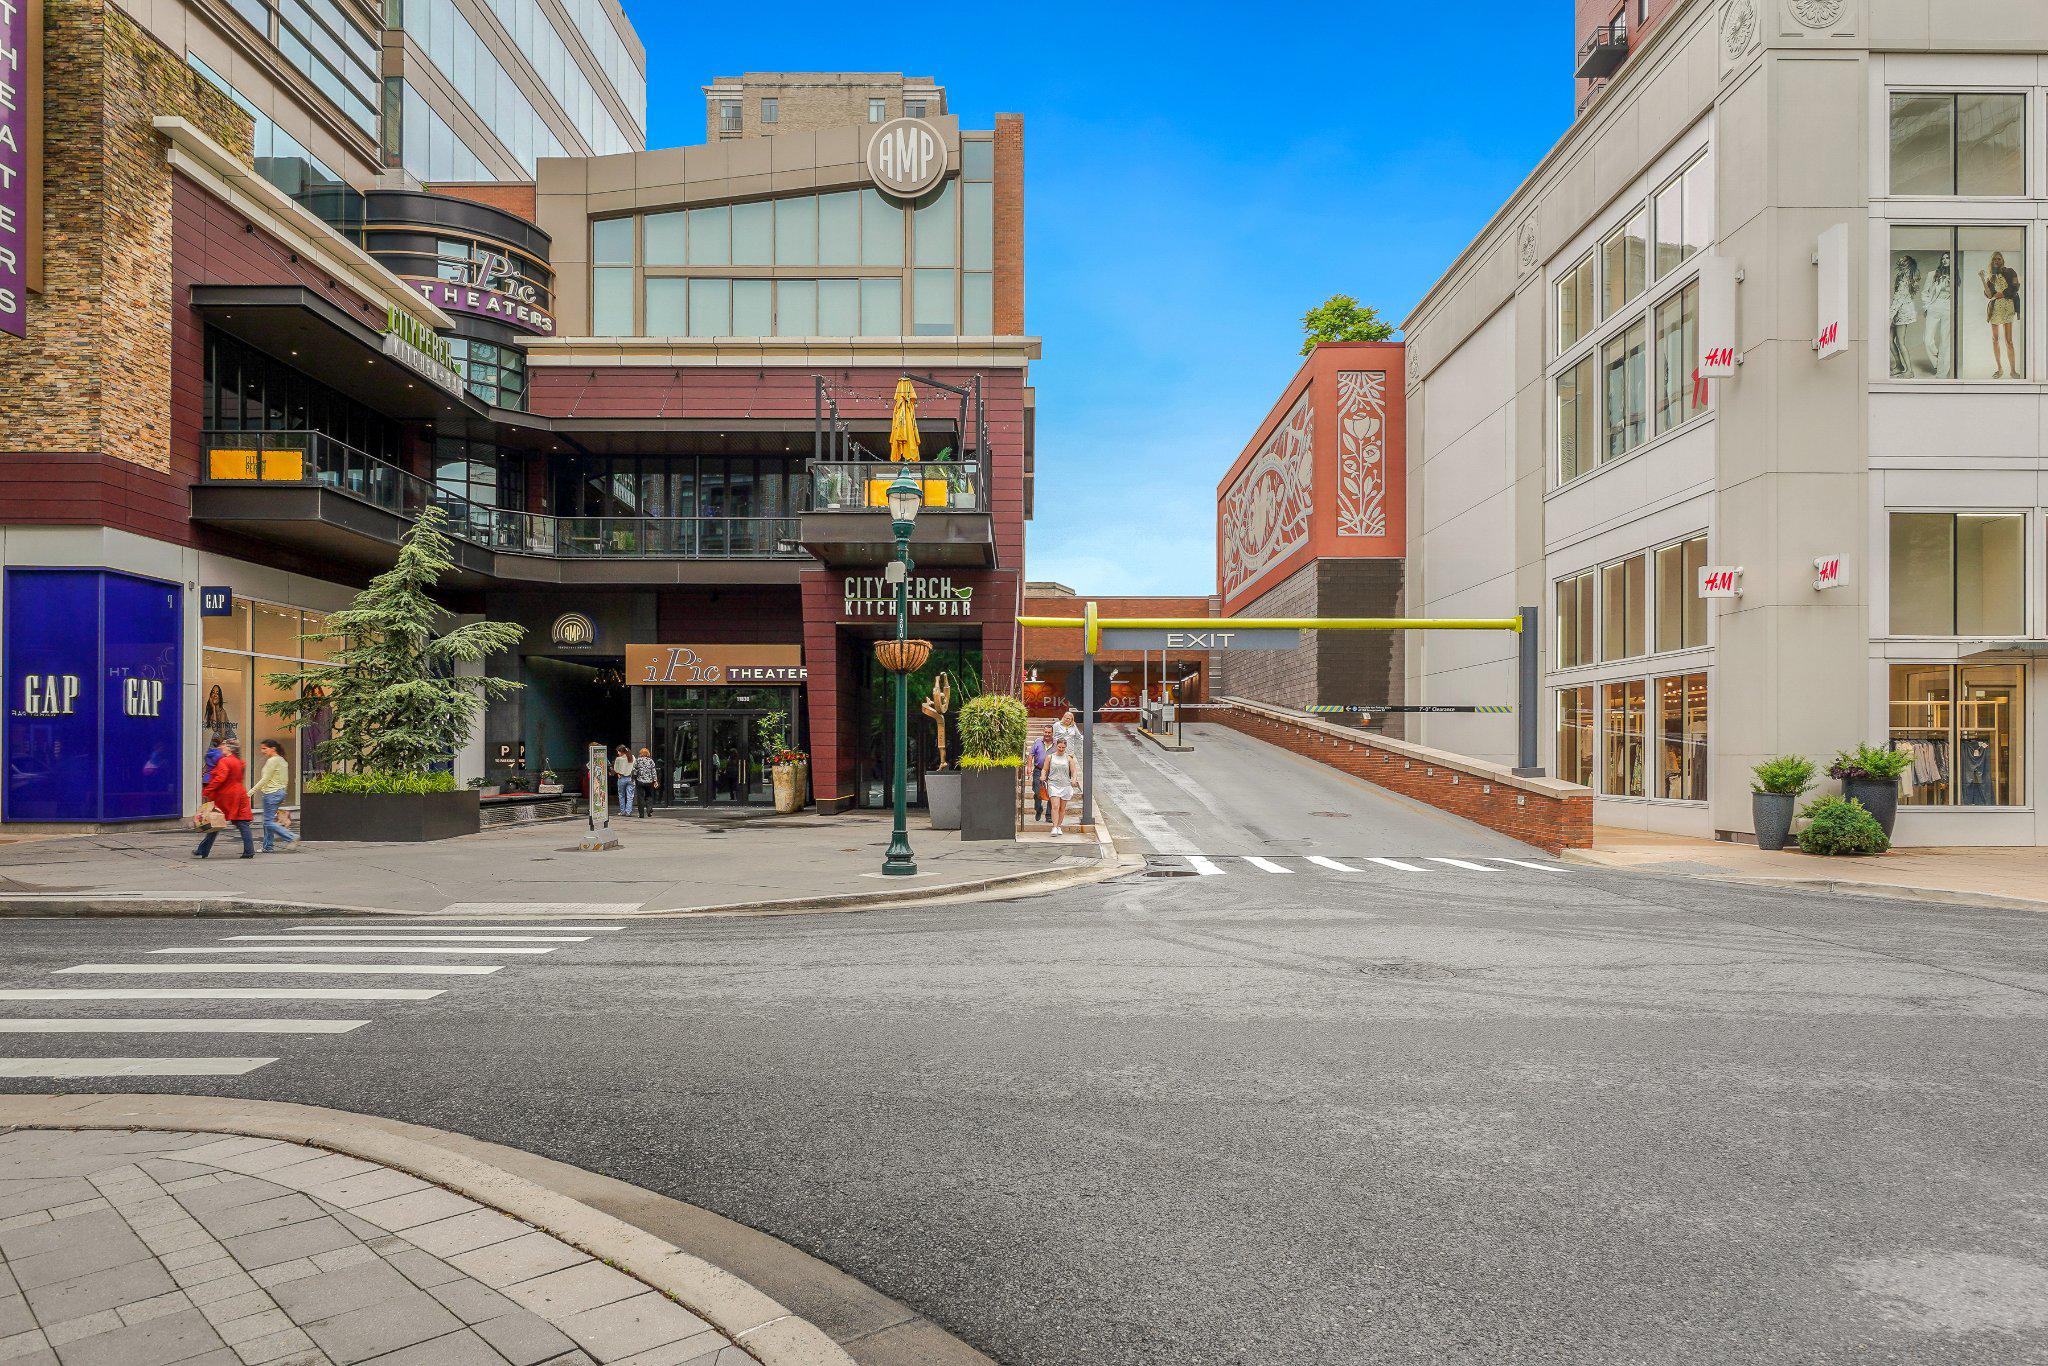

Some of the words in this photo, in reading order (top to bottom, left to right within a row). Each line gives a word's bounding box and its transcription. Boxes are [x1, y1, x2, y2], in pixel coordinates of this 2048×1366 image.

[880, 127, 934, 183] AMP
[449, 250, 537, 304] iPic
[420, 284, 553, 332] THEATERS
[390, 304, 418, 347] CITY
[418, 325, 453, 369] PERCH
[1818, 321, 1839, 350] H&M
[1705, 347, 1733, 367] H&M
[1705, 572, 1733, 591] H&M
[1819, 559, 1839, 582] H&M
[845, 577, 884, 599] CITY
[205, 594, 225, 609] GAP
[845, 601, 920, 615] KITCHN
[564, 624, 581, 641] AMP
[1166, 633, 1235, 648] EXIT
[642, 647, 721, 683] iPic
[25, 674, 80, 714] GAP
[126, 678, 163, 717] GAP
[1043, 696, 1073, 708] PIK
[1104, 696, 1136, 708] OSE
[501, 745, 510, 756] P
